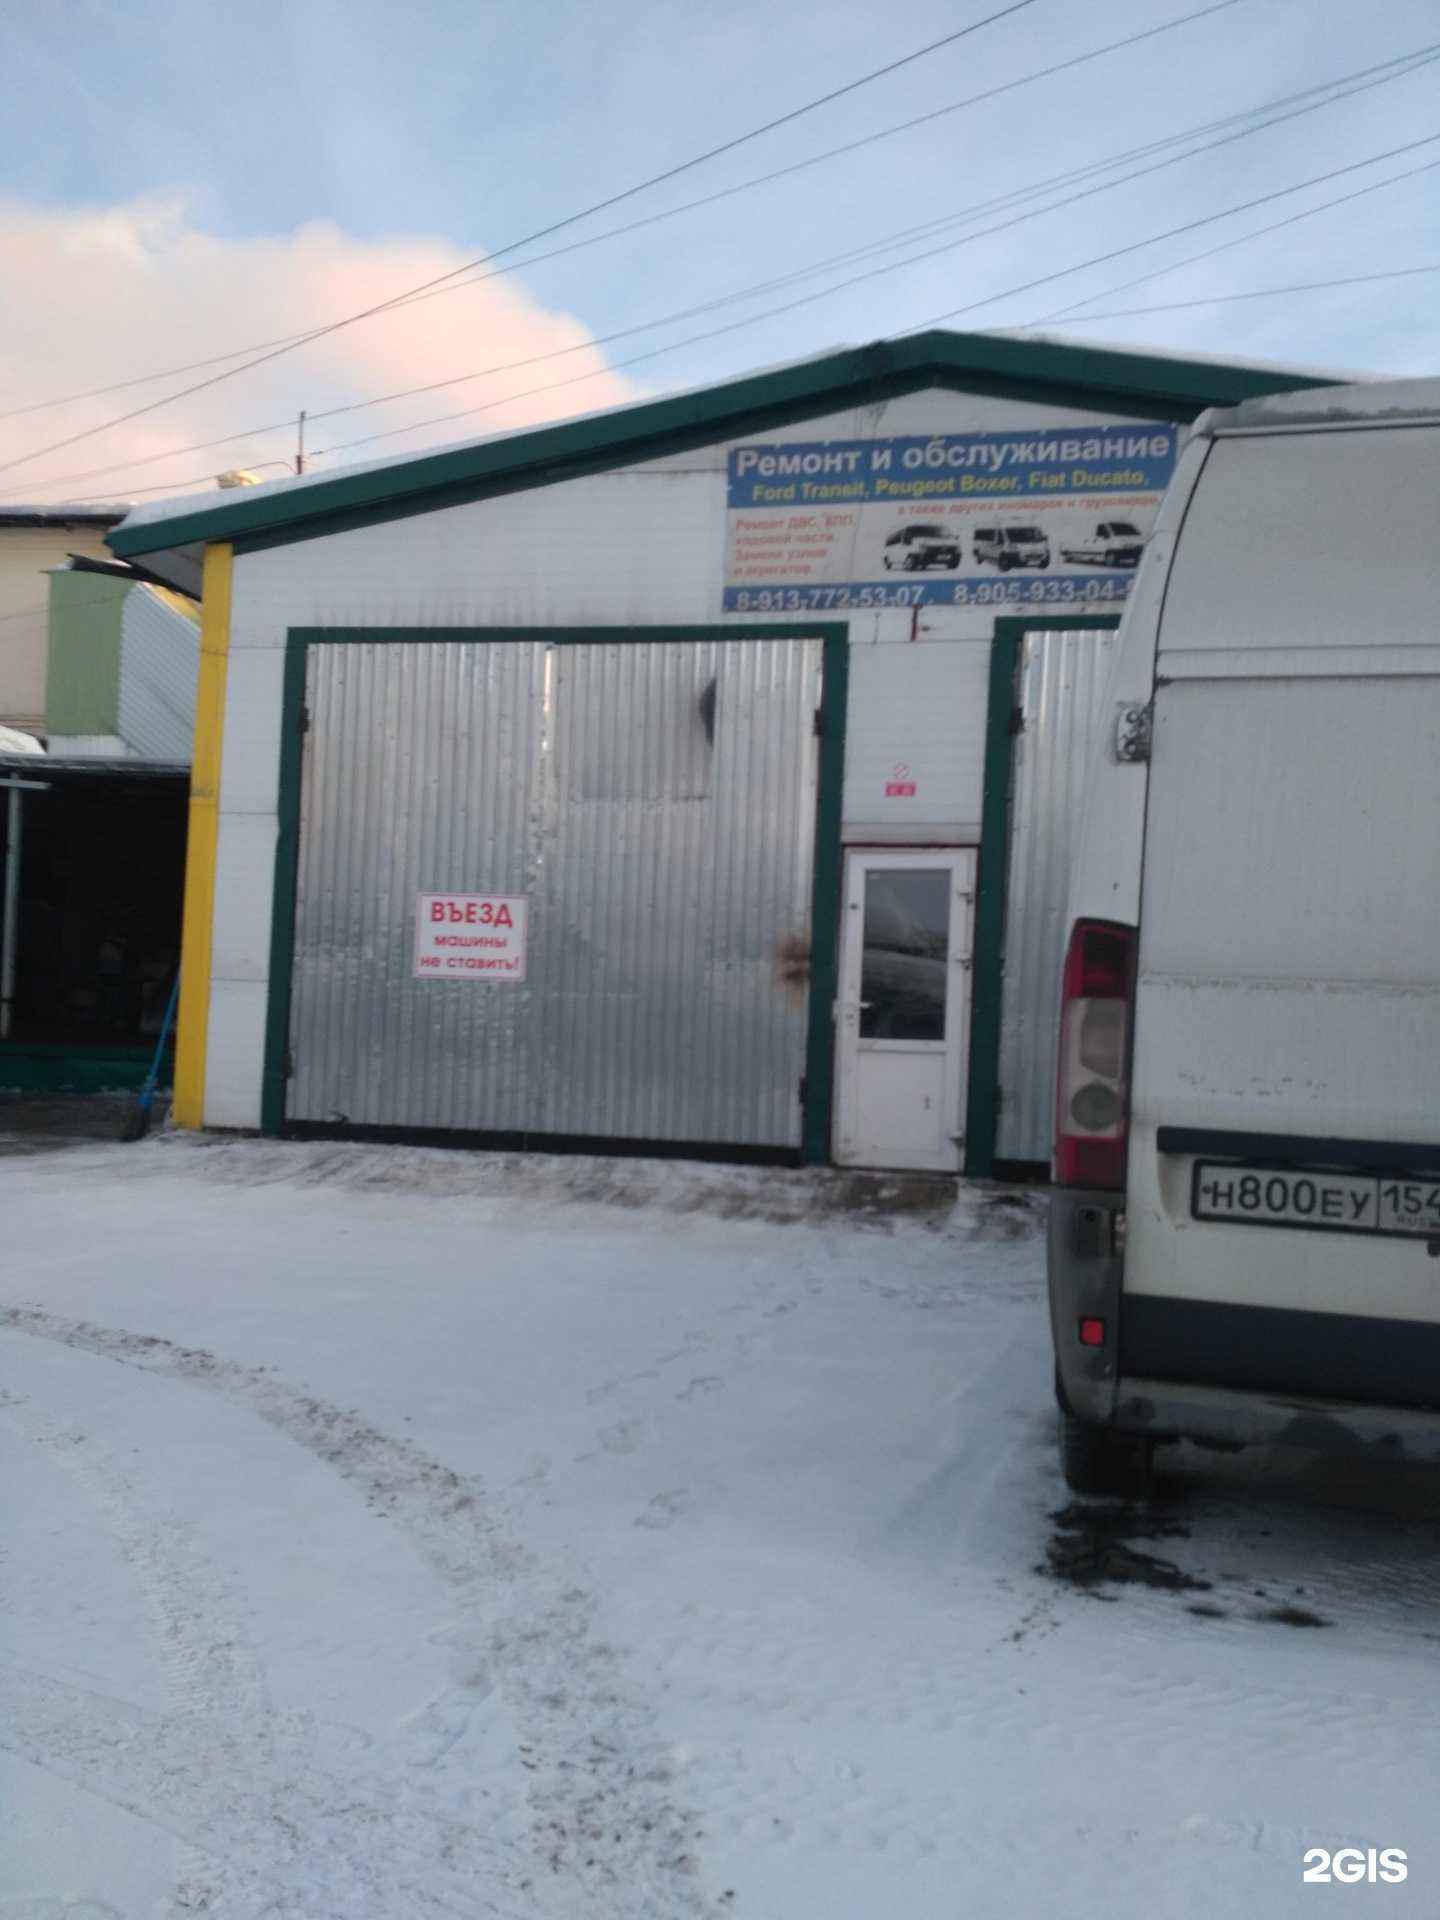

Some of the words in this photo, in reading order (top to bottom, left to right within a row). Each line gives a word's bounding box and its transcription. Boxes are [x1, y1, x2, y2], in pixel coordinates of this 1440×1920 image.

[735, 448, 863, 477] Ремонт
[871, 448, 892, 471] и
[902, 434, 1170, 473] обслуживание
[752, 484, 796, 501] Ford
[801, 480, 870, 499] Transit,
[875, 477, 956, 497] Peugeot
[961, 474, 1022, 493] Boxer,
[1029, 471, 1066, 488] Fiat
[735, 518, 784, 530] Ремонт
[430, 901, 514, 928] ВЪЕЗД
[433, 935, 507, 948] машины
[420, 956, 442, 968] не
[446, 955, 520, 970] ставить!
[1211, 1174, 1371, 1219] Н800ЕУ
